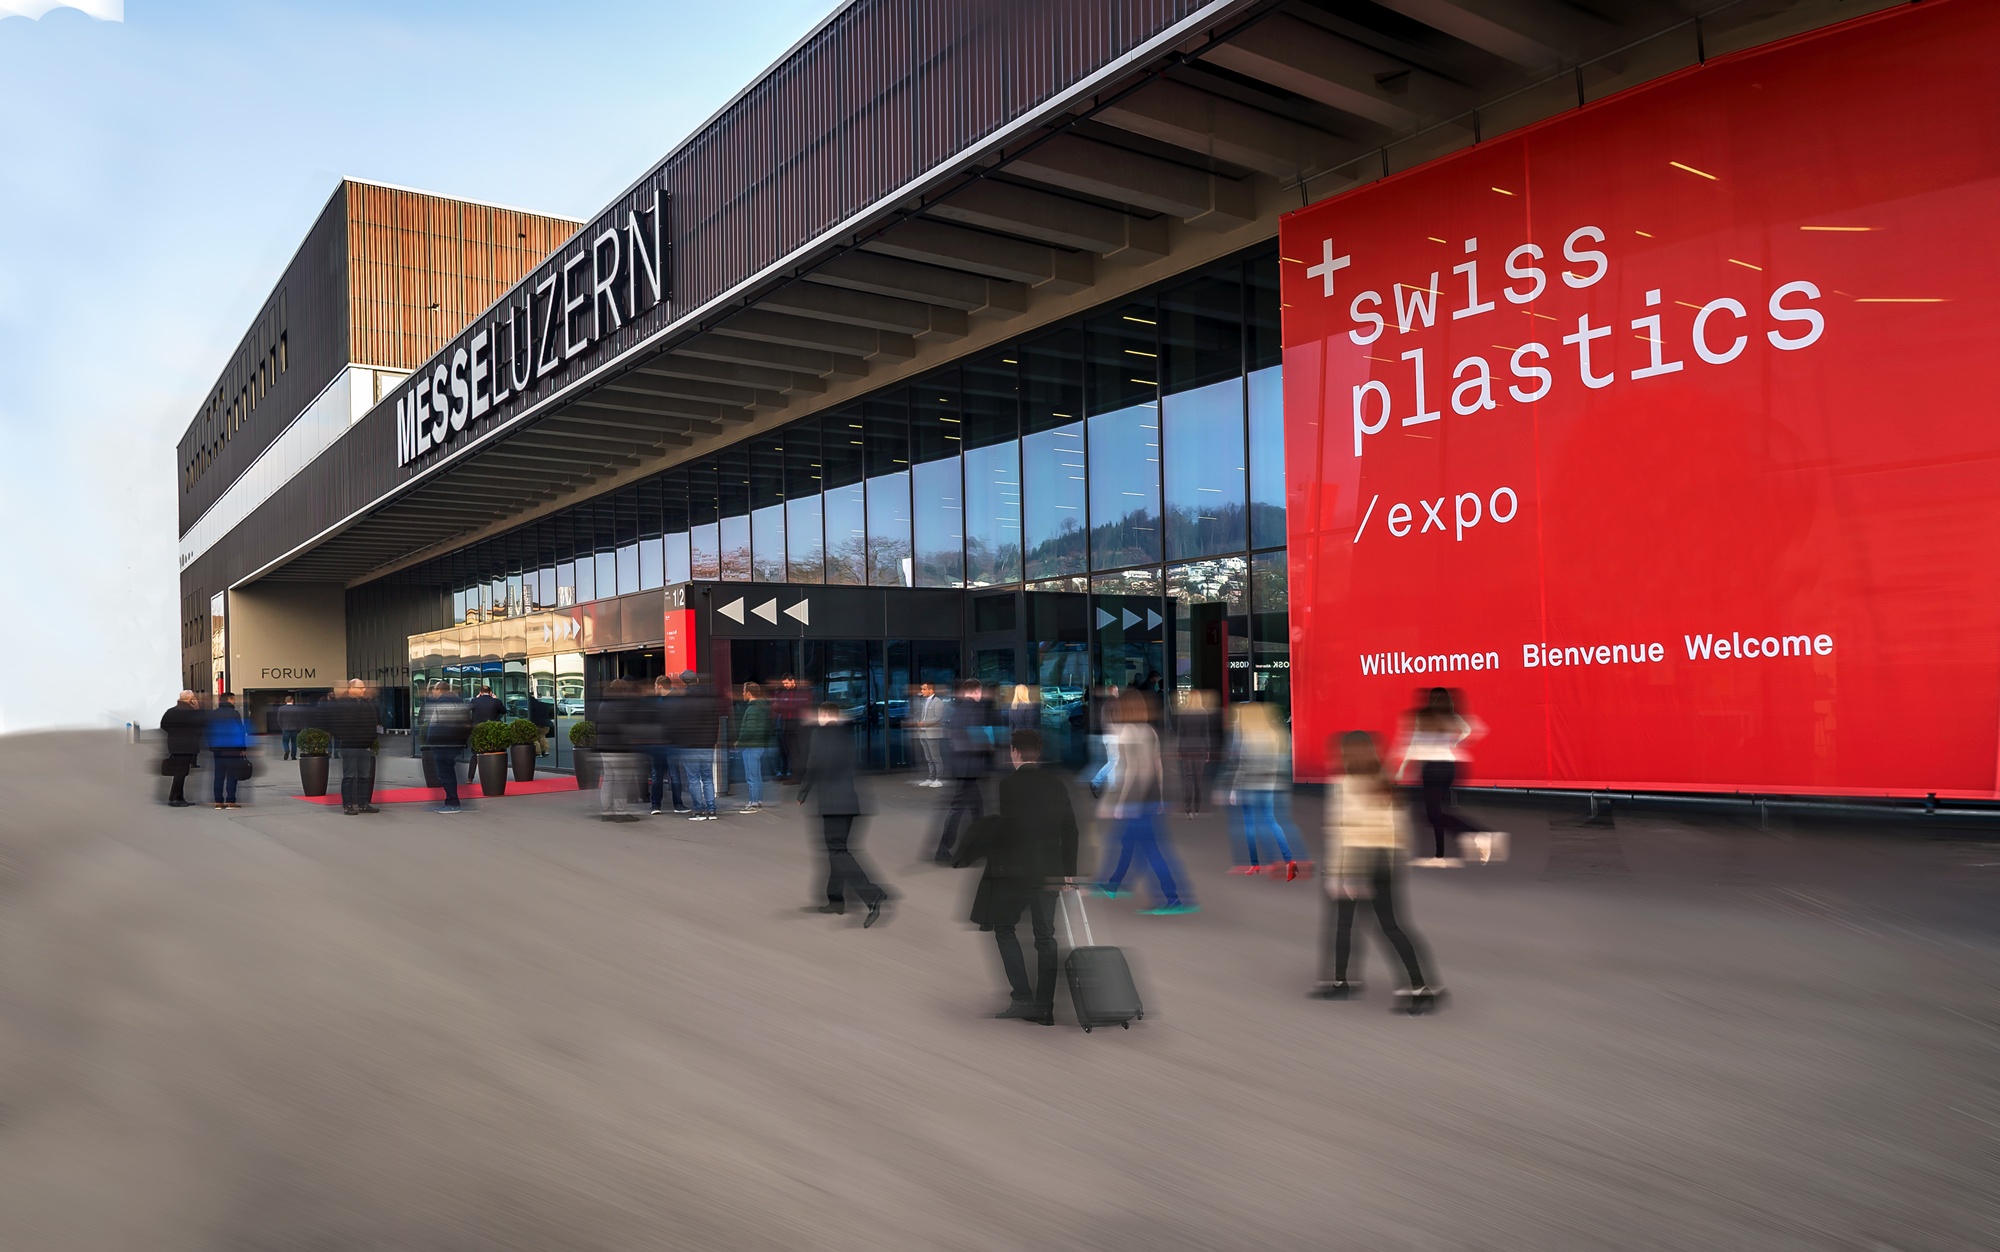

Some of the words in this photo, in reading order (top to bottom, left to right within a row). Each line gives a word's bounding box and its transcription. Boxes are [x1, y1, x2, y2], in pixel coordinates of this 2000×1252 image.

[1349, 226, 1608, 346] swiss
[1352, 281, 1826, 457] plastics
[1353, 486, 1518, 544] /expo
[261, 668, 316, 679] FORUM
[1360, 651, 1499, 676] Willkommen
[1523, 640, 1665, 668] Bienvenue
[1684, 632, 1834, 661] Welcome
